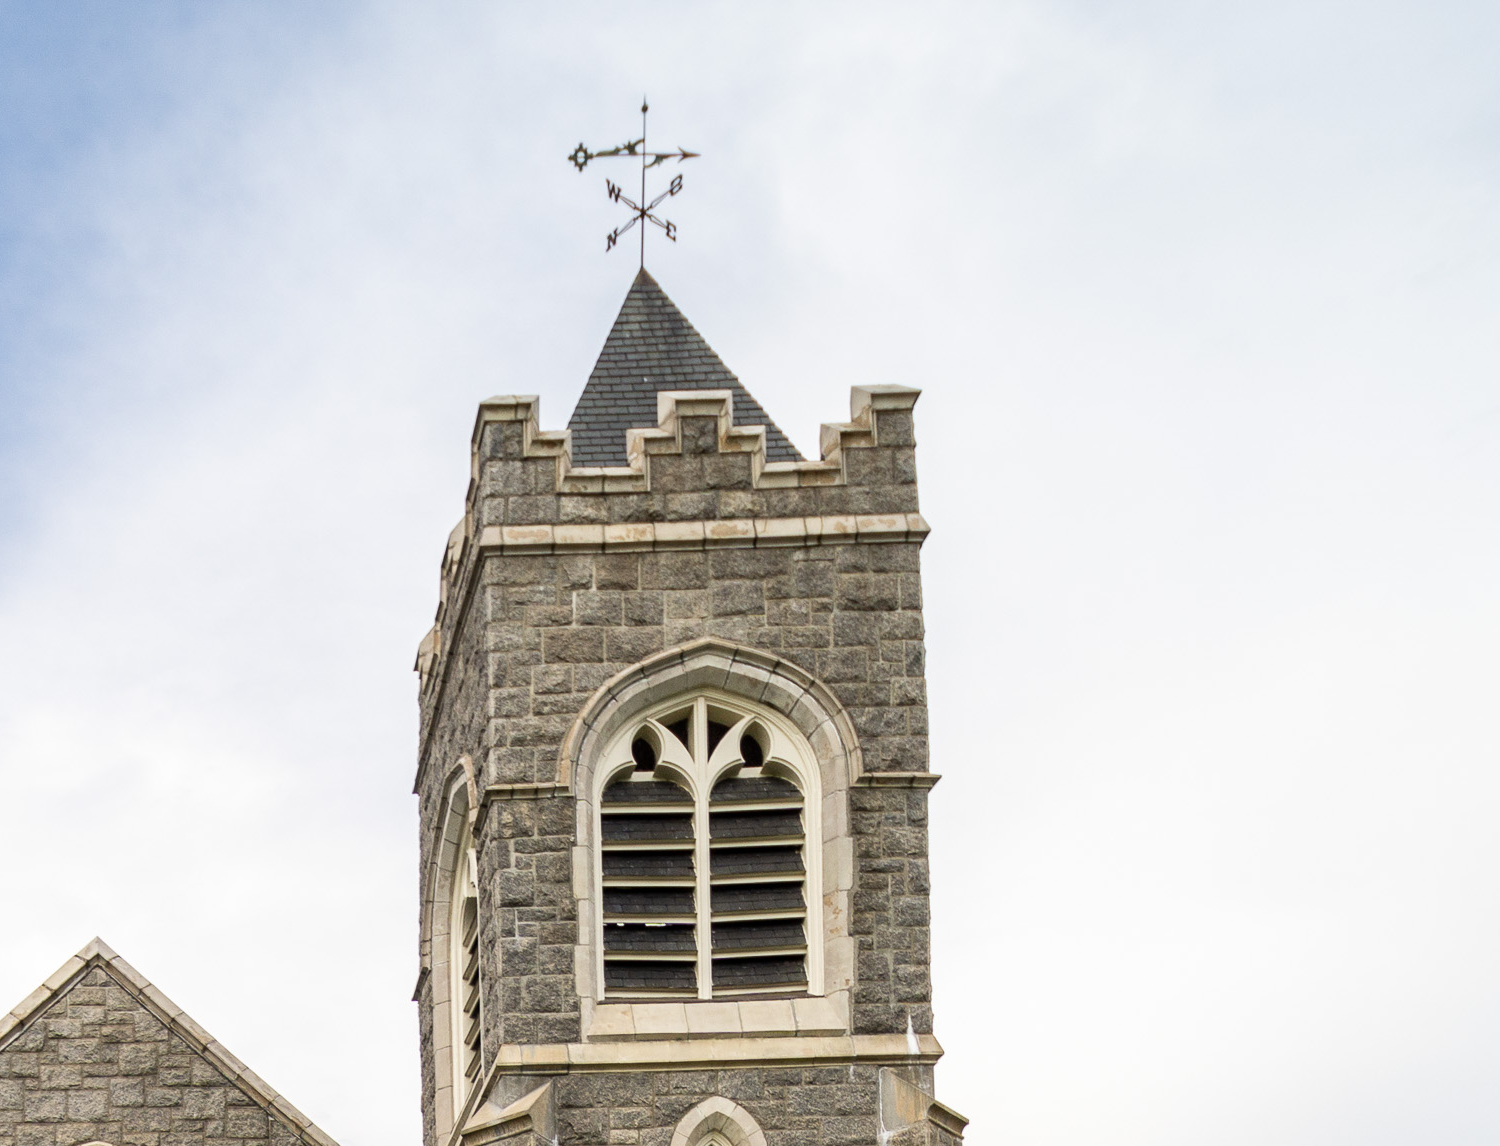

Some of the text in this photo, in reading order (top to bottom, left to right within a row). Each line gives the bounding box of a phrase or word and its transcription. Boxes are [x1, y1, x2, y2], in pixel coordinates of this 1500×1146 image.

[605, 178, 621, 203] W
[606, 226, 618, 252] N
[666, 220, 677, 242] E
